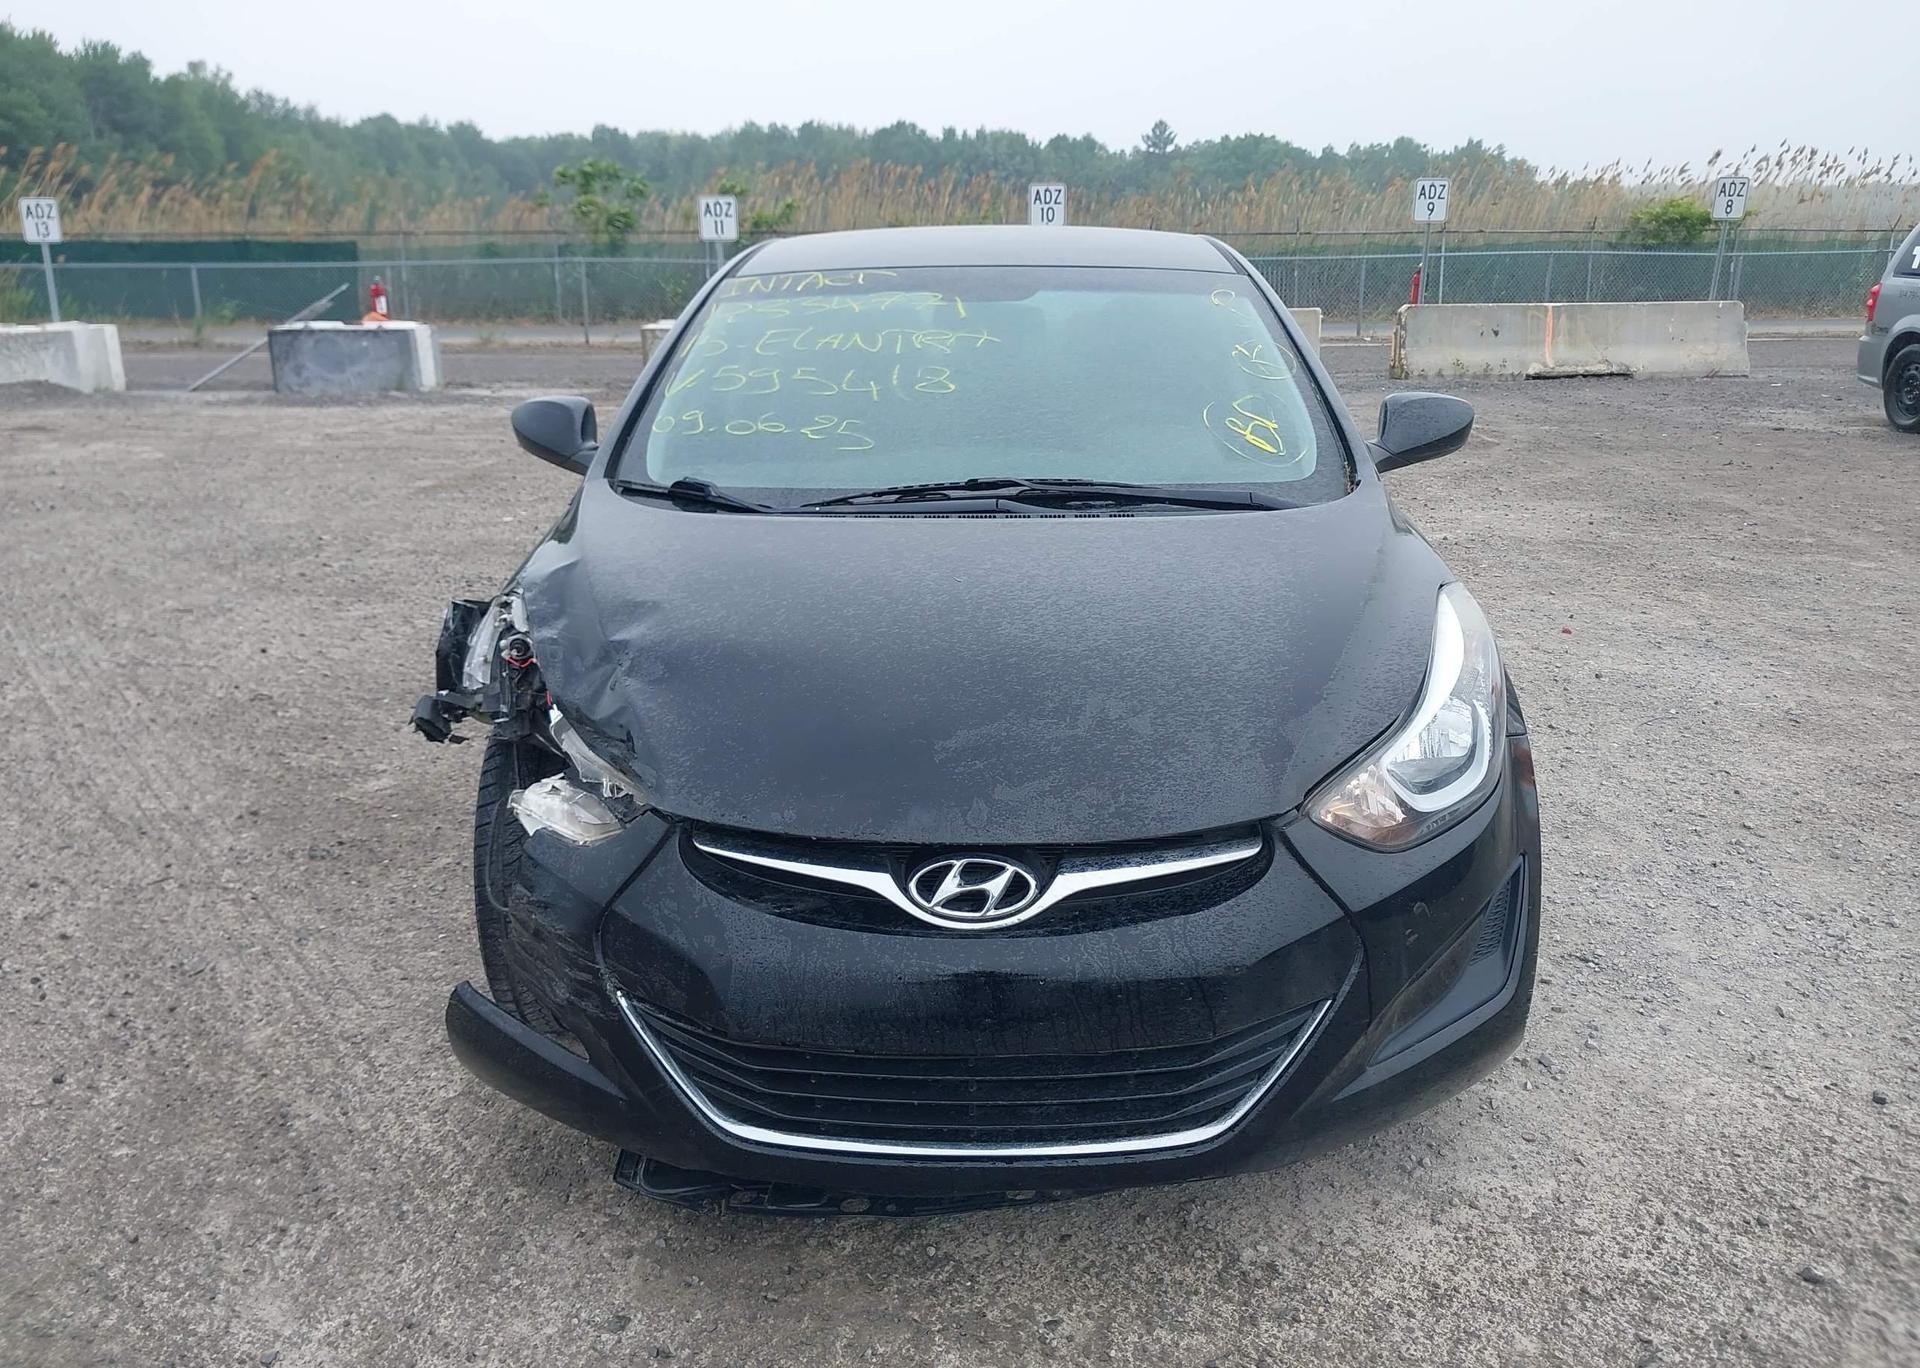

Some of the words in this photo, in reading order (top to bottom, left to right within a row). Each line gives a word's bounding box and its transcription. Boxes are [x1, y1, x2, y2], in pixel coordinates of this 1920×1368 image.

[1033, 189, 1062, 205] ADZ
[1418, 184, 1446, 200] ADZ
[1718, 182, 1746, 197] ADZ
[26, 203, 56, 219] ADZ
[704, 201, 732, 217] ADZ
[1427, 202, 1435, 217] 9
[1725, 199, 1734, 214] 8
[1040, 207, 1055, 223] 10
[35, 221, 50, 238] 13
[714, 220, 724, 235] 11
